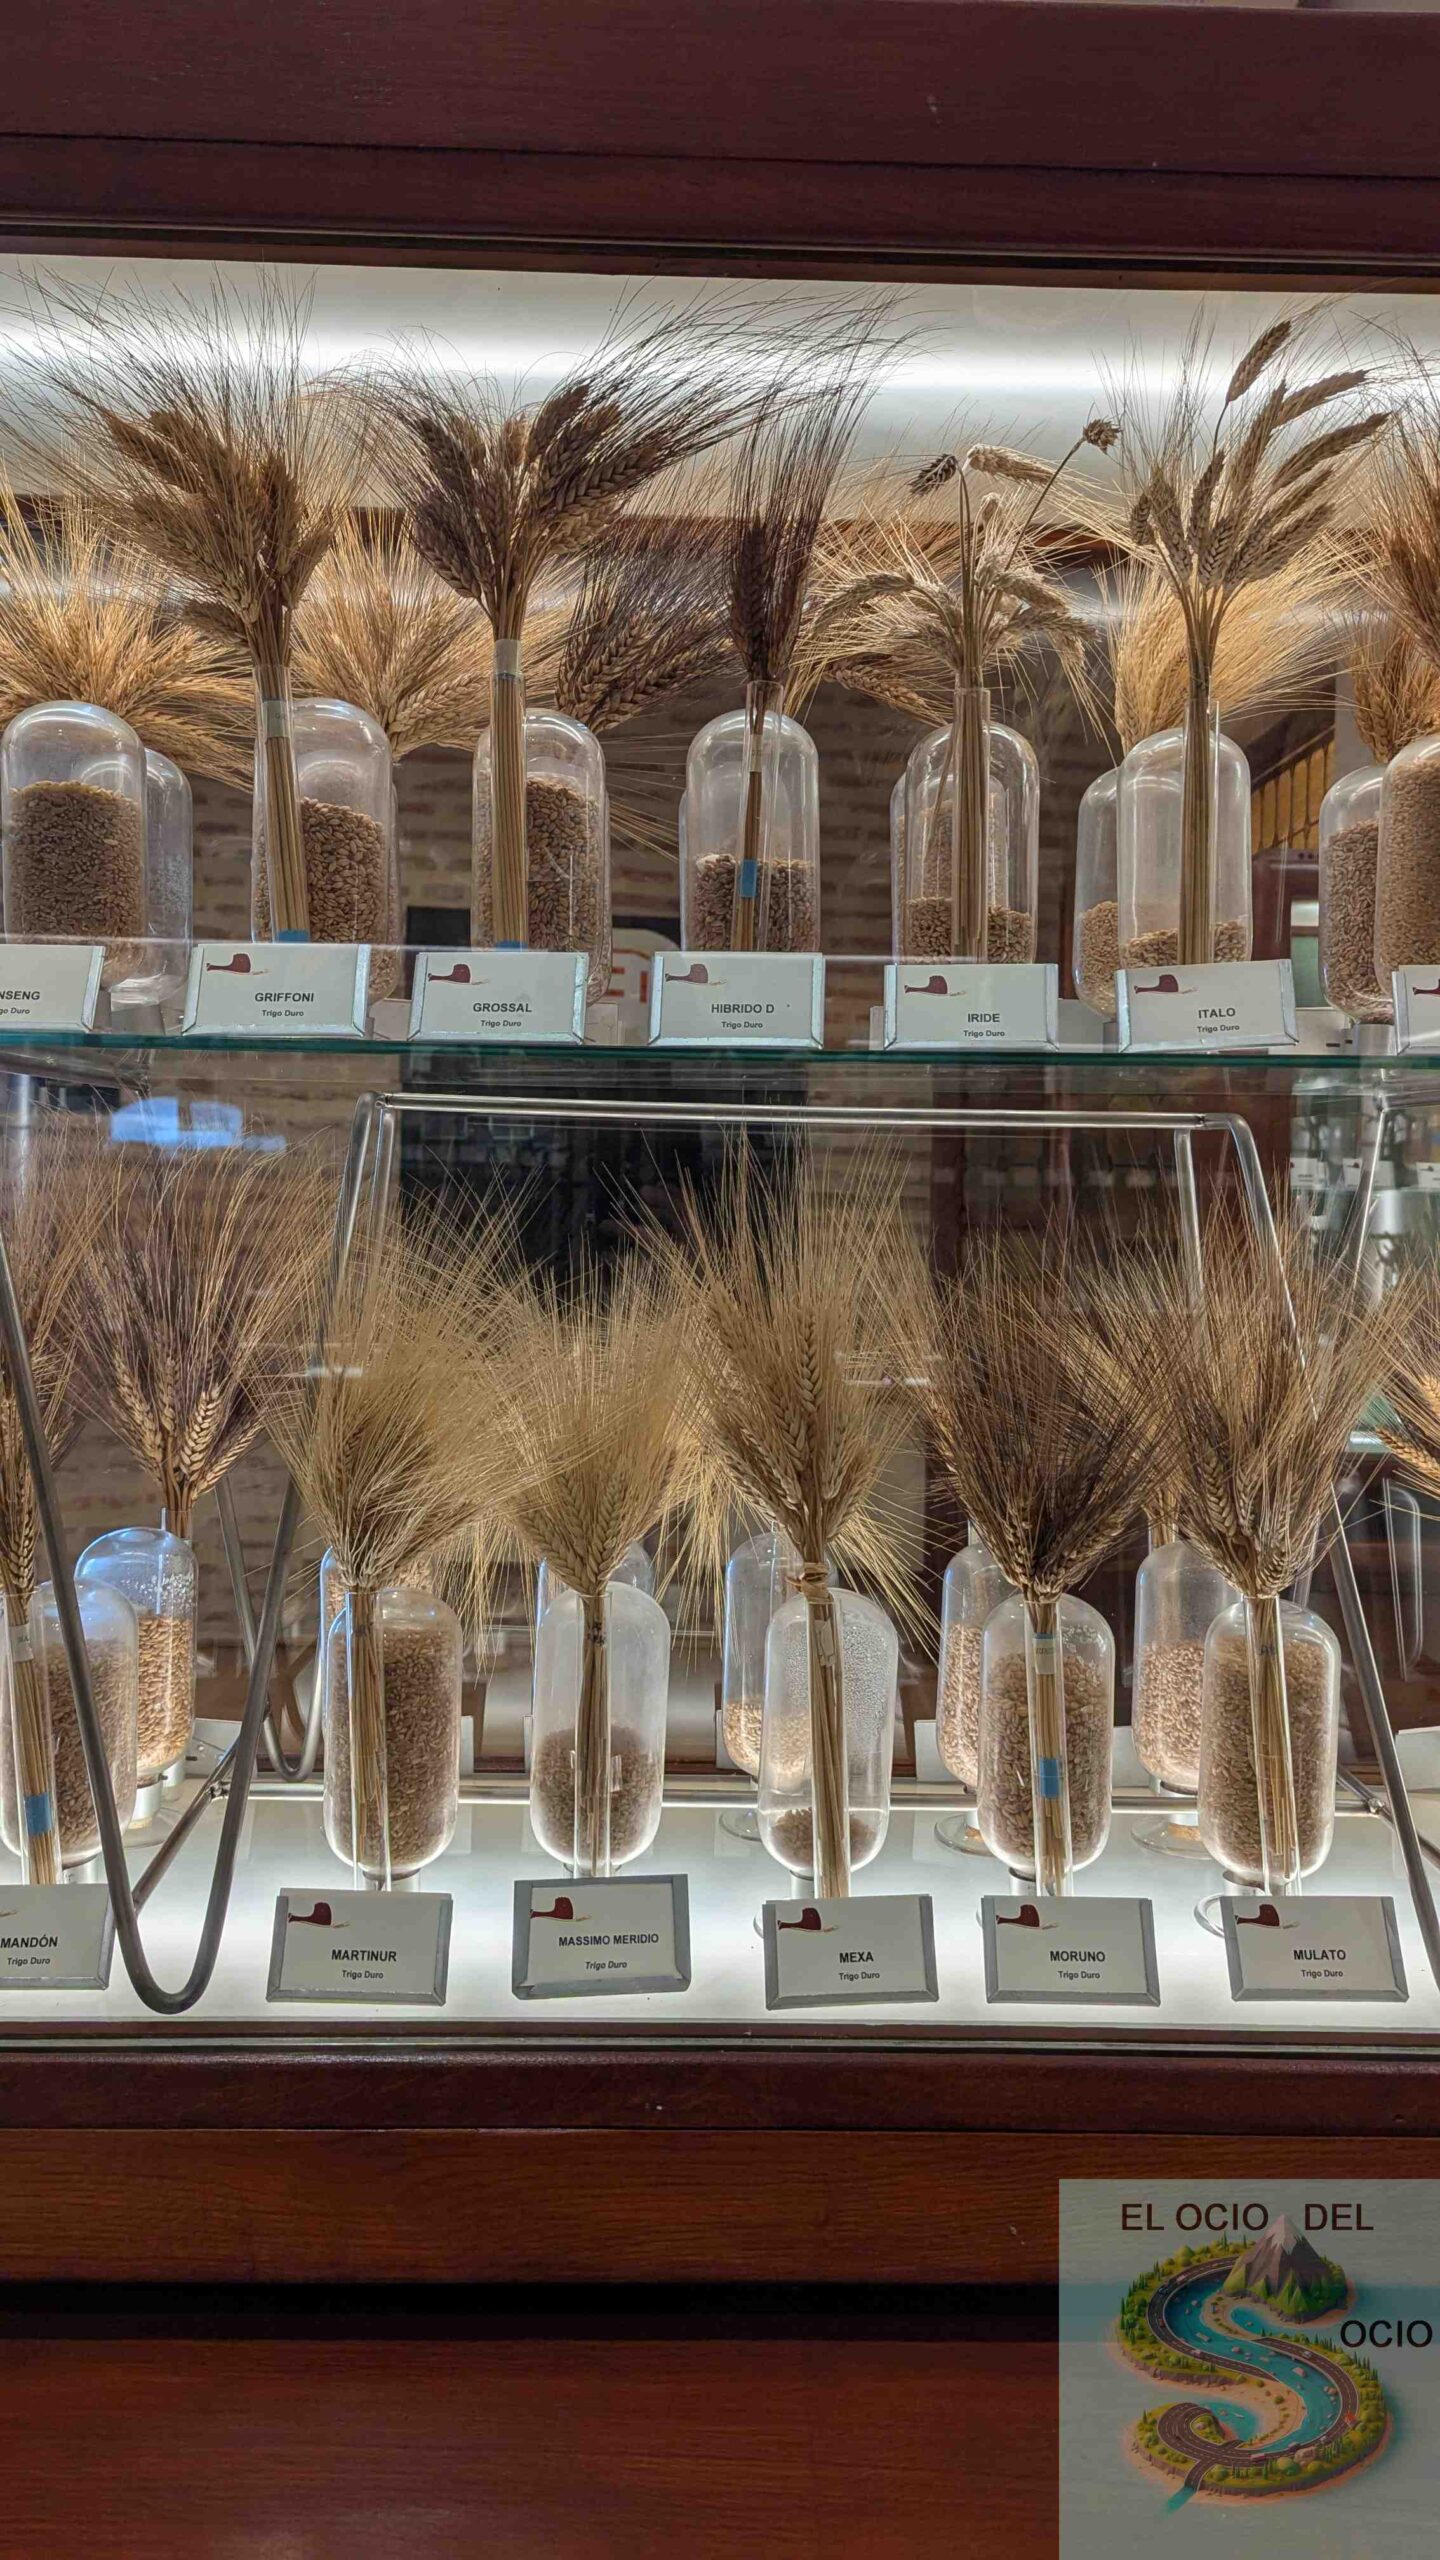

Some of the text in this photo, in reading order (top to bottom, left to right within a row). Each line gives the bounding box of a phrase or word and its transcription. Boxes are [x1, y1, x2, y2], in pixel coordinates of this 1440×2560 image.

[254, 992, 315, 1003] GRIFFONI
[10, 1006, 31, 1015] Duro
[472, 1002, 533, 1013] GROSSAL
[711, 1003, 775, 1014] HIBRIDO D
[1198, 1007, 1236, 1019] ITALO
[261, 1009, 305, 1018] Trigo Duro
[967, 1013, 1001, 1023] IRIDE
[480, 1019, 522, 1029] Trigo Duro
[721, 1020, 764, 1030] Trigo Duro
[1196, 1024, 1240, 1034] Trigo Duro
[963, 1029, 1006, 1039] Trigo Duro
[0, 1934, 59, 1949] MANDÓN
[558, 1933, 660, 1947] MASSIMO MERIDIO
[331, 1949, 397, 1962] MARTINUR
[839, 1951, 875, 1964] MEXA
[1049, 1950, 1106, 1963] MORUNO
[1293, 1949, 1347, 1961] MULATO
[7, 1956, 51, 1967] Trigo Duro
[585, 1960, 628, 1972] Trigo Duro
[341, 1969, 384, 1981] Trigo Duro
[838, 1971, 881, 1982] Trigo Duro
[1057, 1970, 1101, 1981] Trigo Duro
[1300, 1969, 1344, 1980] Trigo Duro
